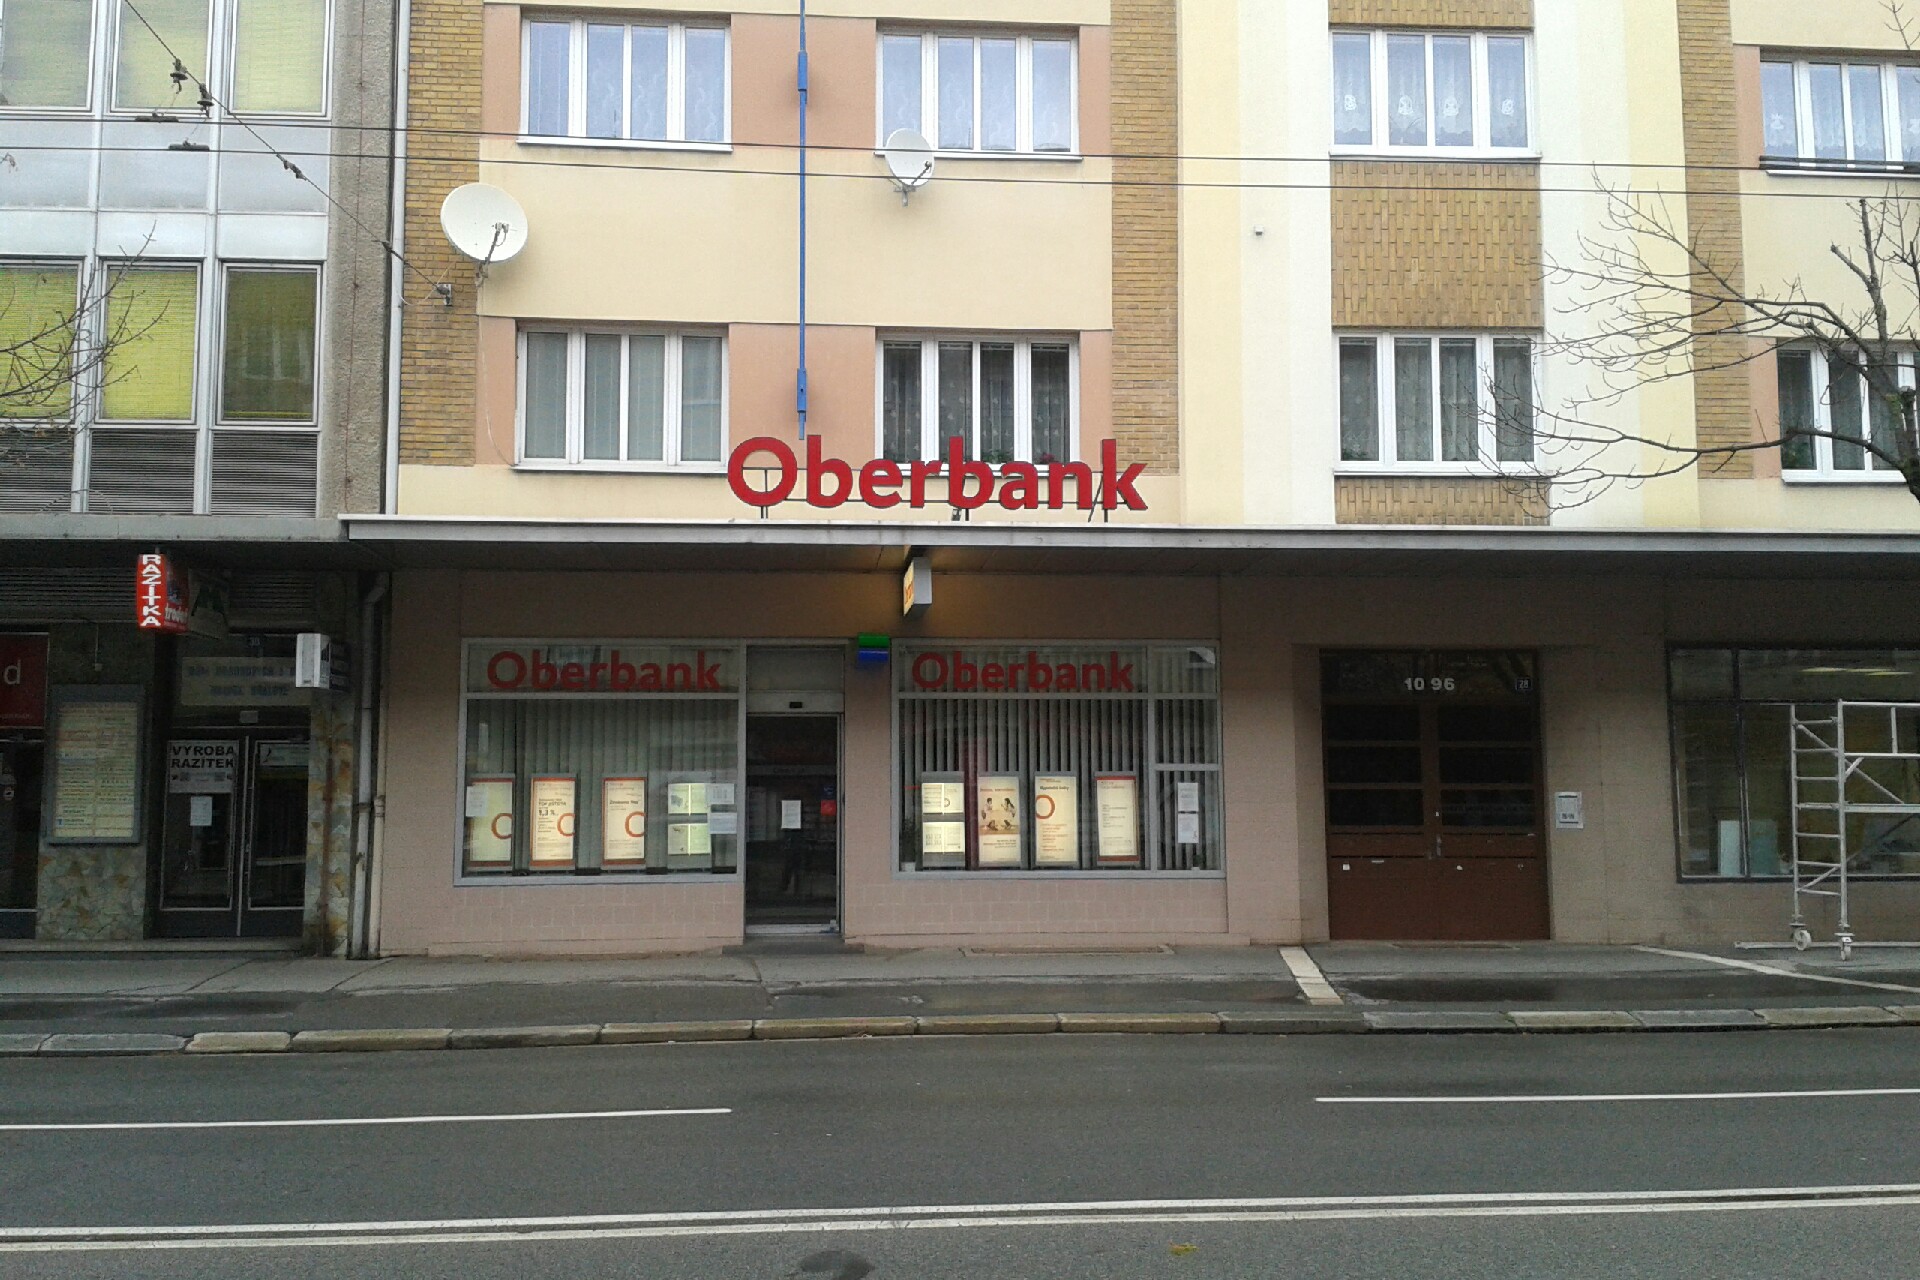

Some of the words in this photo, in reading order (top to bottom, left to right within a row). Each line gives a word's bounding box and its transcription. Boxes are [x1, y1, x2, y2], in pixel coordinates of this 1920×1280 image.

[728, 435, 1148, 511] Oberbank
[487, 650, 721, 690] Oberbank
[912, 651, 1133, 690] Oberbank
